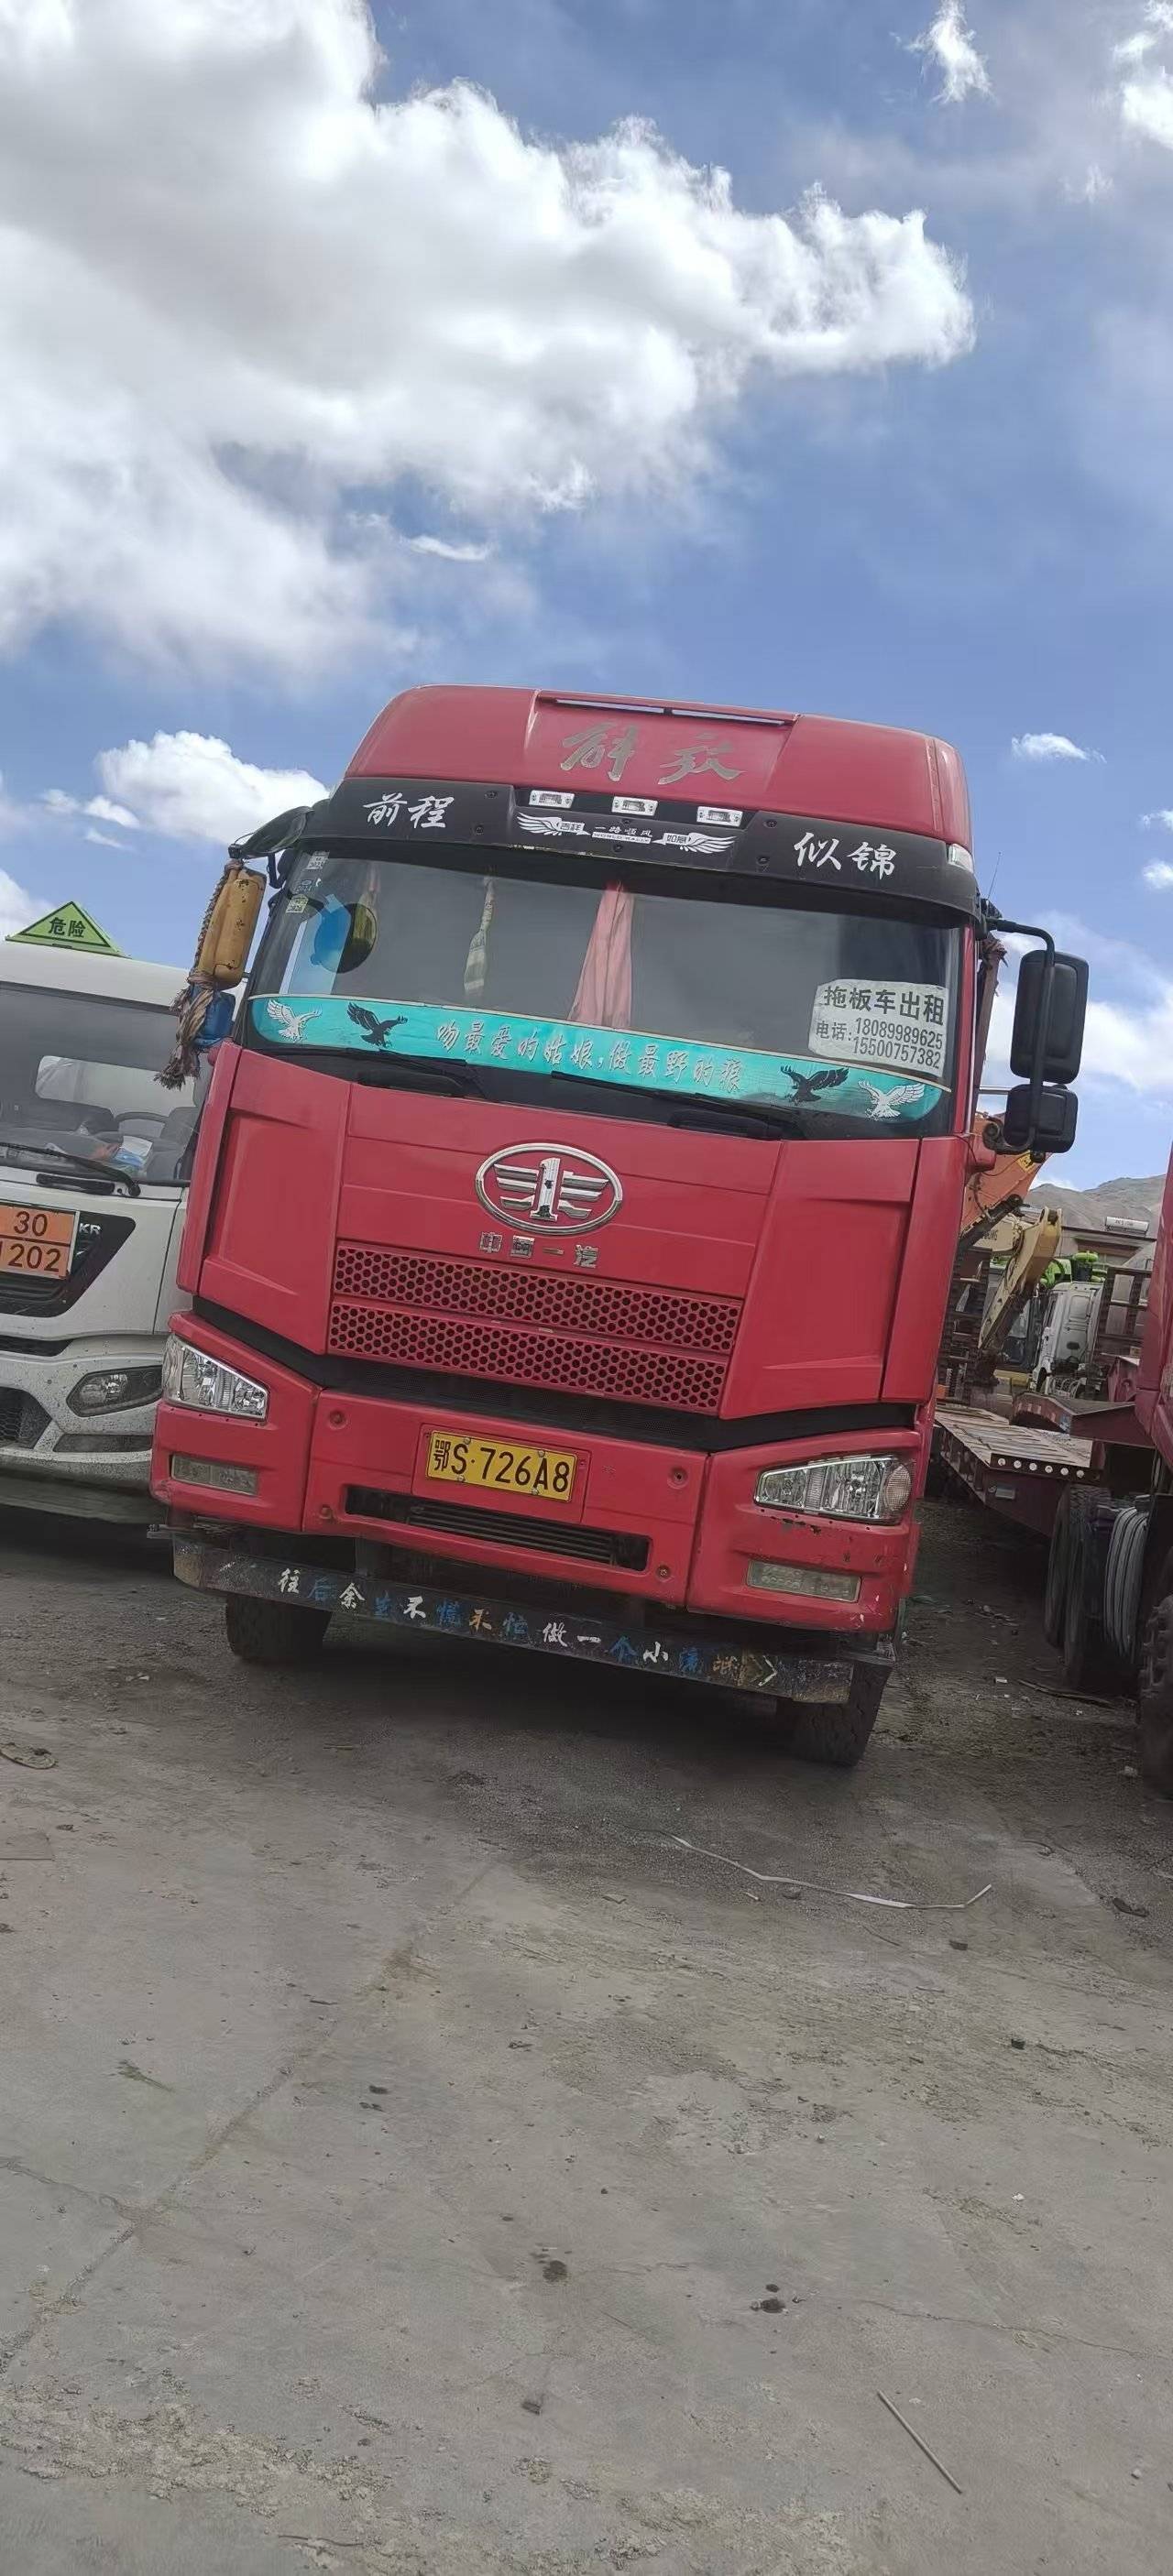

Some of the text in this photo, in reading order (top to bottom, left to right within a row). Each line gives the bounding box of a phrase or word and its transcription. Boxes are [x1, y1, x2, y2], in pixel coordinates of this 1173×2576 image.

[363, 791, 455, 829] 前程
[794, 832, 897, 880] 似锦
[48, 916, 87, 938] 危险
[823, 985, 944, 1026] 拖板车出租
[855, 1017, 944, 1051] 18089989625
[853, 1036, 941, 1069] 15500757382
[14, 1210, 49, 1237] 30
[478, 1231, 600, 1260] 中国一汽
